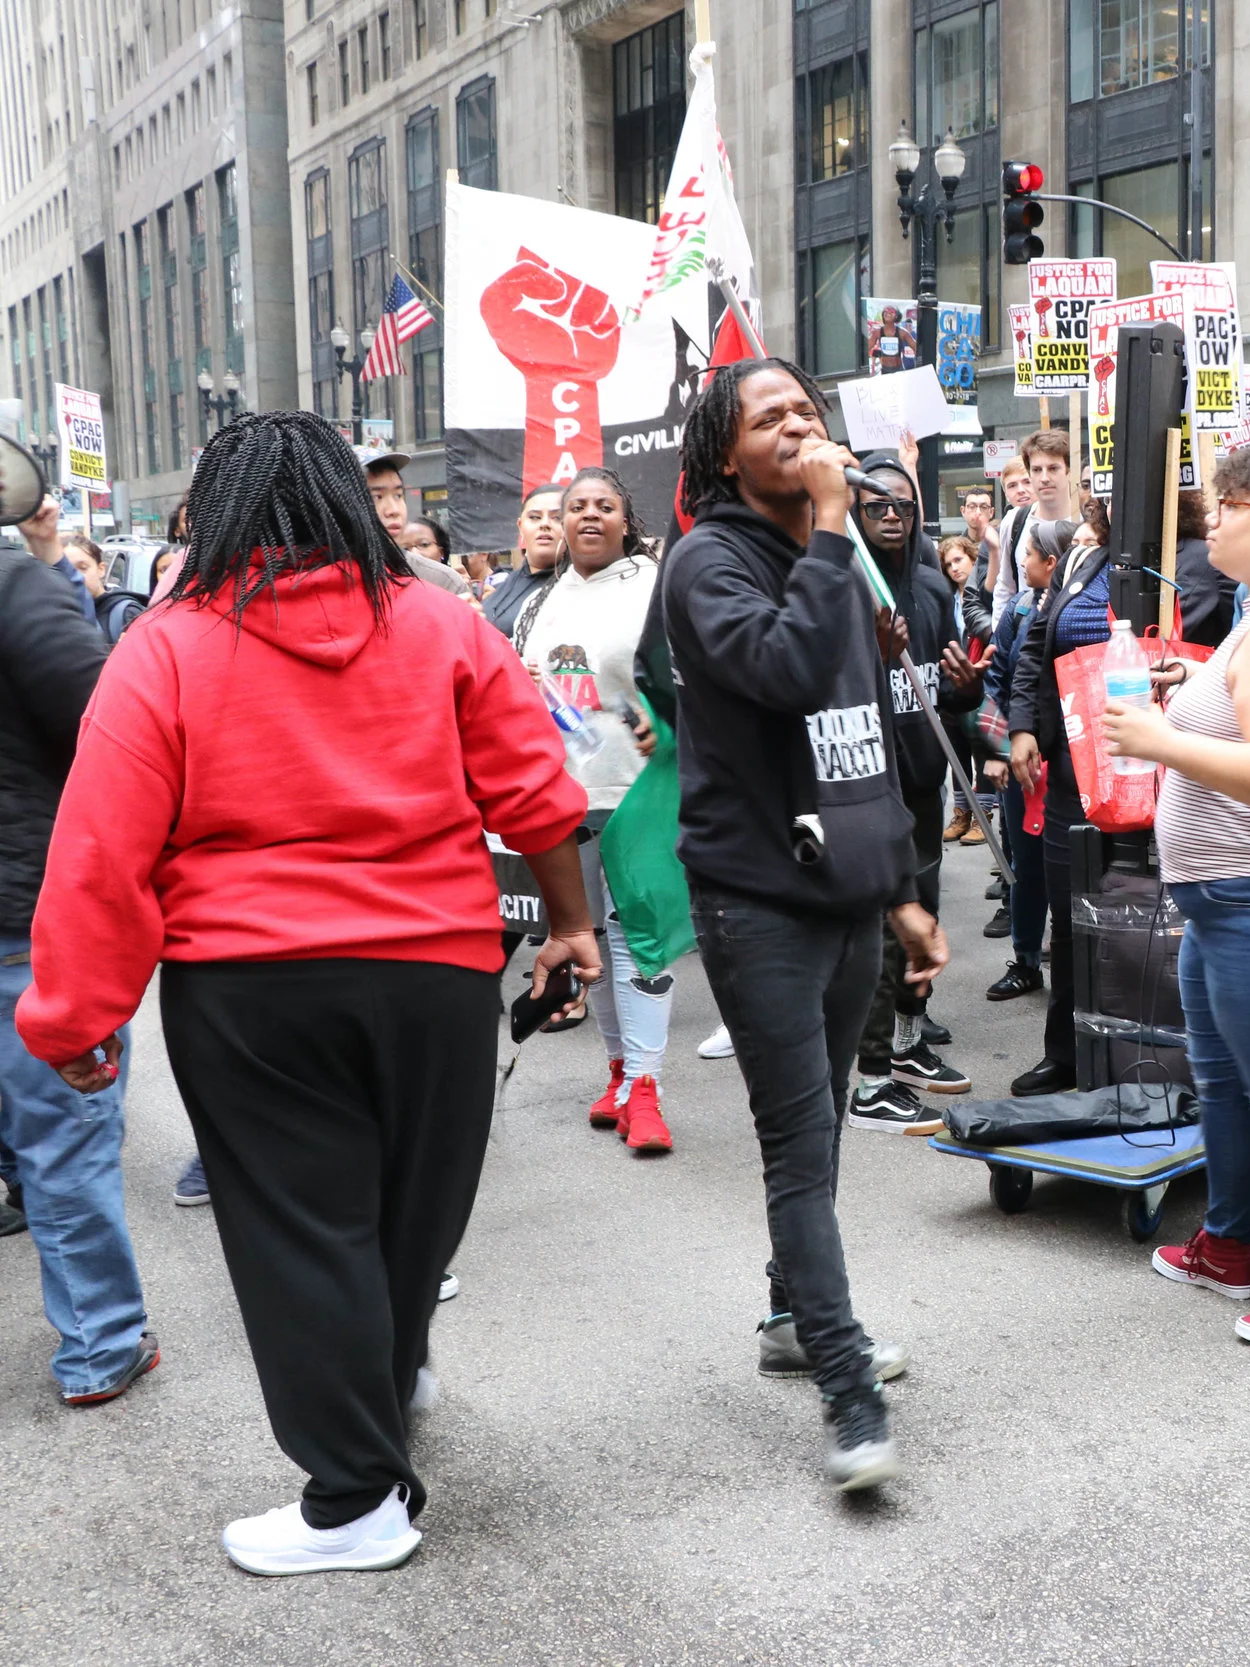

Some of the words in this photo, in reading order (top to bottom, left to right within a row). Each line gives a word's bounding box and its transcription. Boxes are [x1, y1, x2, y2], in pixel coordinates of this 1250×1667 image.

[1031, 263, 1084, 277] JUSTICE
[1087, 262, 1112, 276] FOR
[1032, 276, 1112, 296] LAQUAN
[1091, 302, 1150, 329] JUSTICE
[1152, 295, 1183, 314] FOR
[939, 310, 980, 337] CHI
[939, 336, 974, 361] CA
[939, 361, 974, 388] GO
[73, 418, 102, 437] CPAC
[75, 434, 102, 452] NOW
[69, 449, 103, 466] CONVICT
[70, 460, 104, 479] VANDYKE
